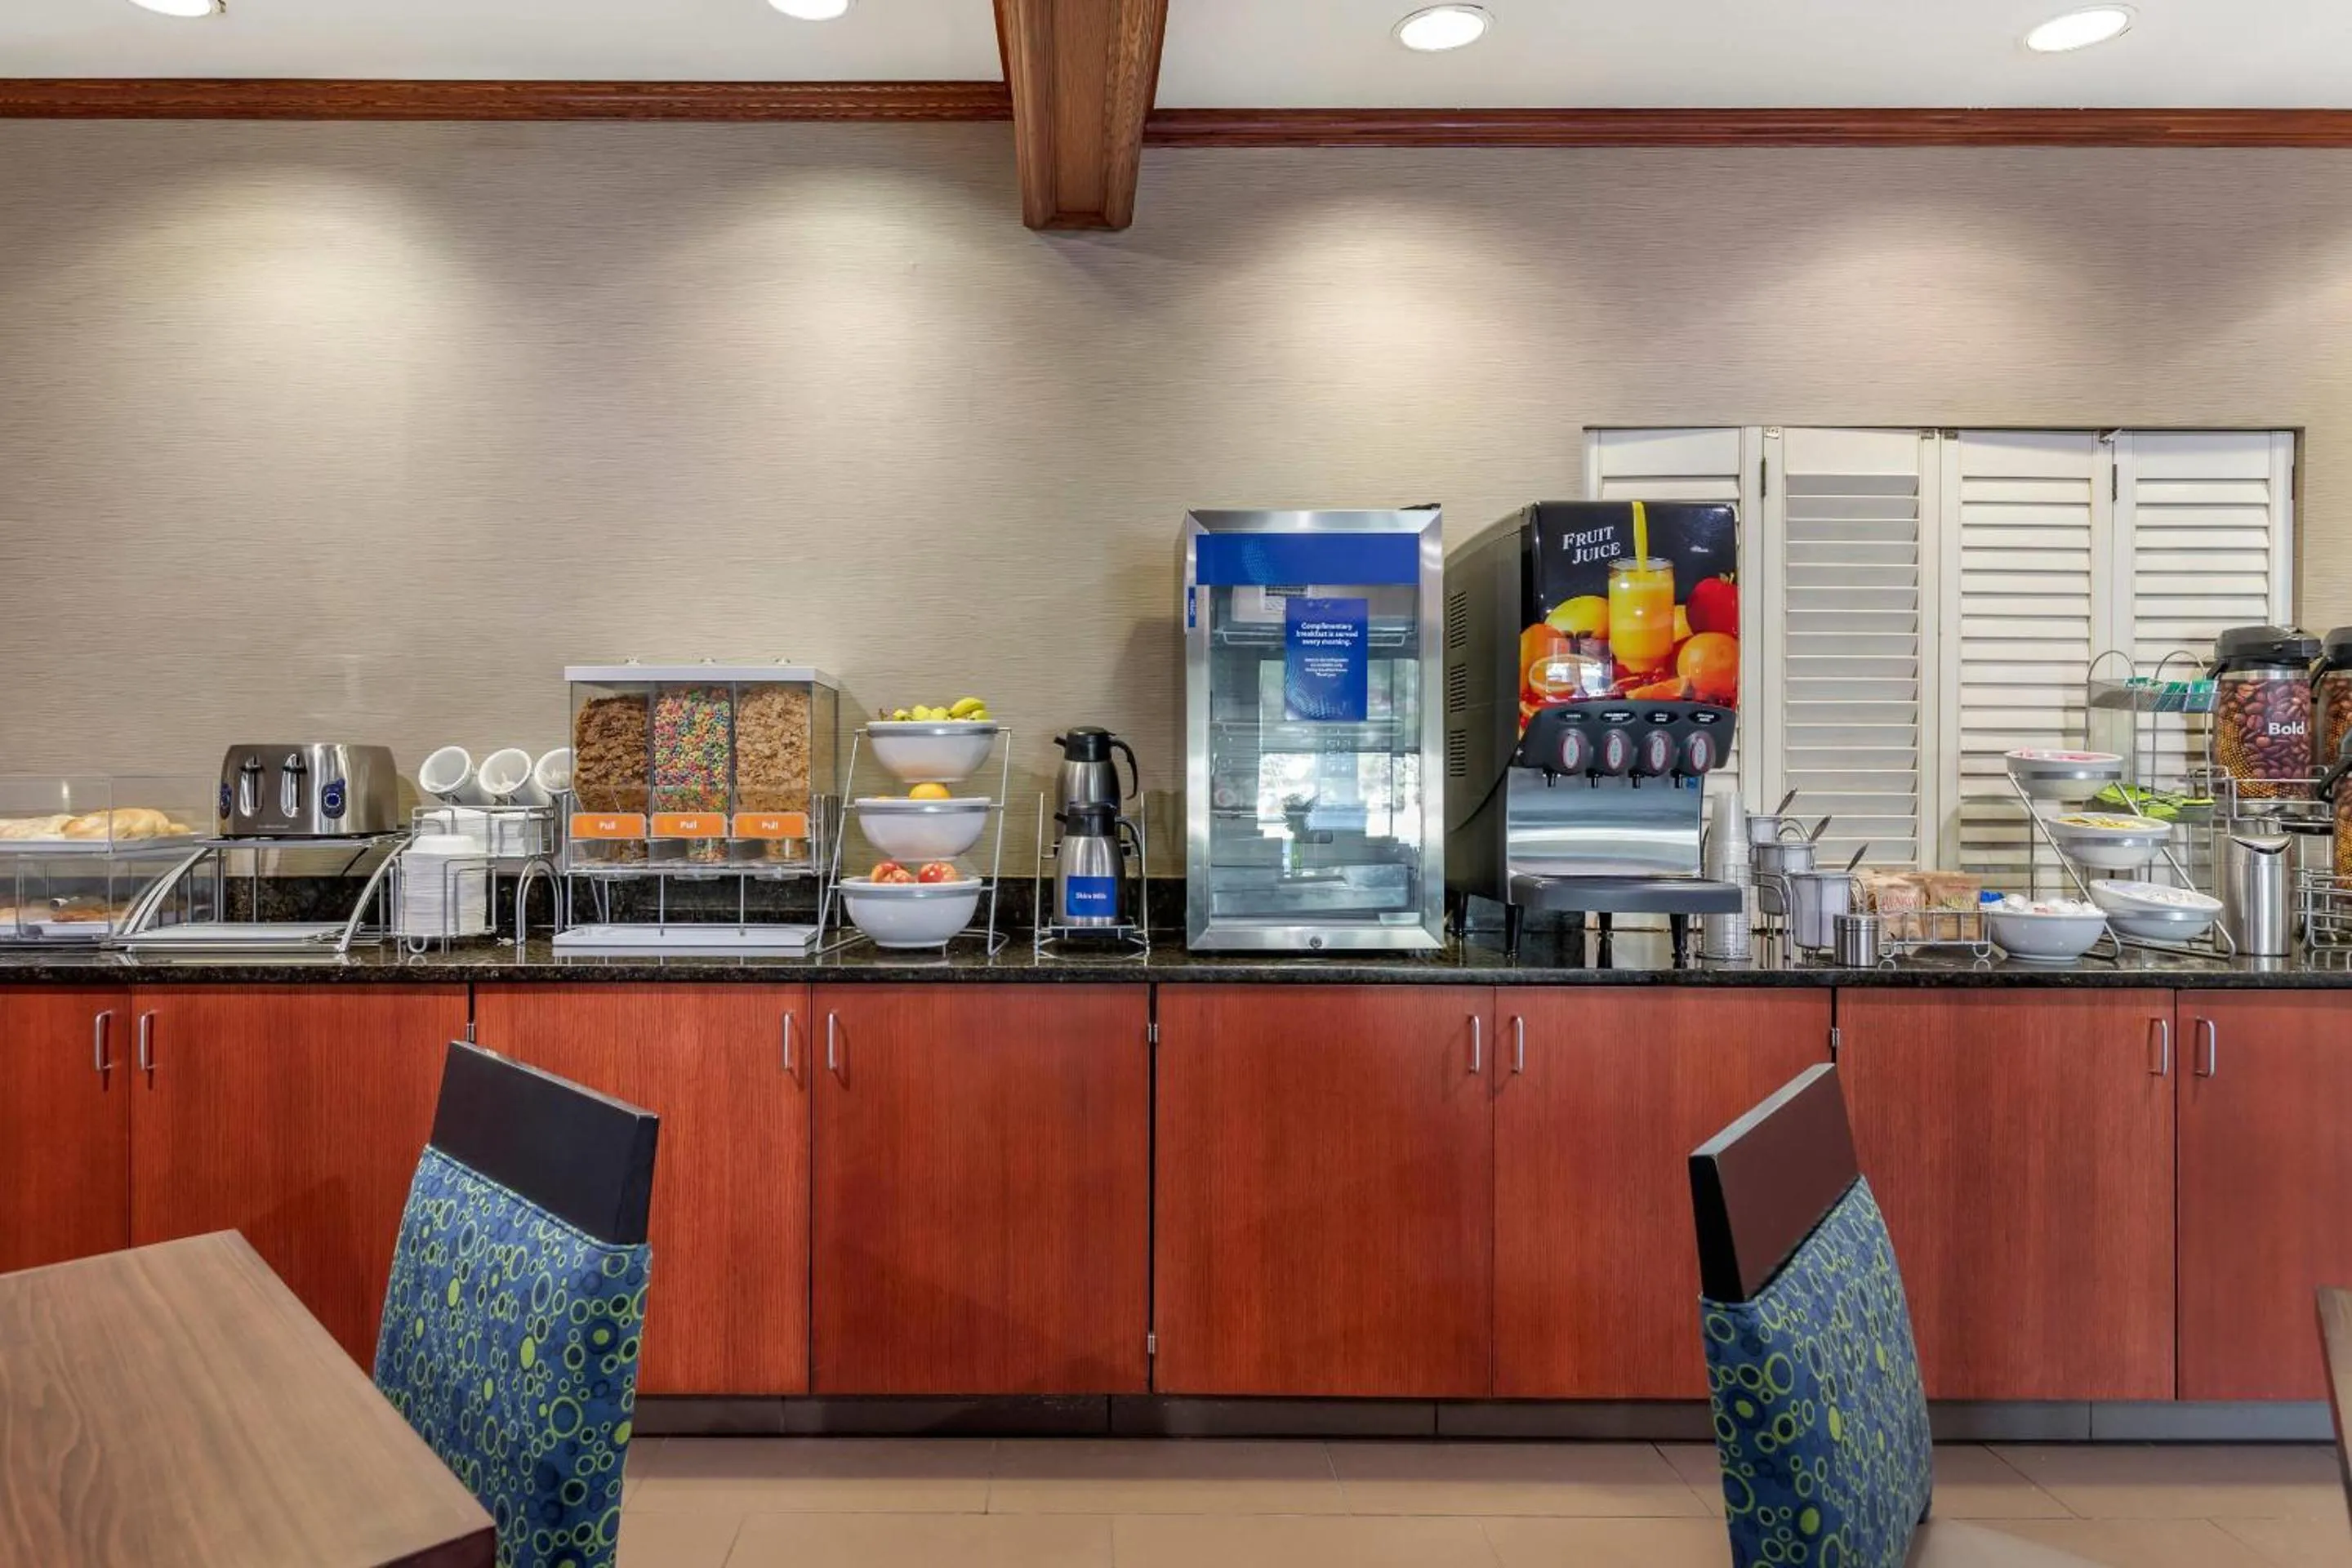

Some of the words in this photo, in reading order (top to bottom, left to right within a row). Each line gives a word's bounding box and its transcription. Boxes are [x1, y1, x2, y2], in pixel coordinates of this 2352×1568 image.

[1562, 526, 1615, 550] FRUIT
[1572, 541, 1621, 564] JUICE
[1301, 621, 1352, 630] Complimentary
[2269, 721, 2305, 735] Bold
[599, 821, 616, 830] Pull
[680, 820, 697, 829] Pull
[762, 821, 779, 830] Pull
